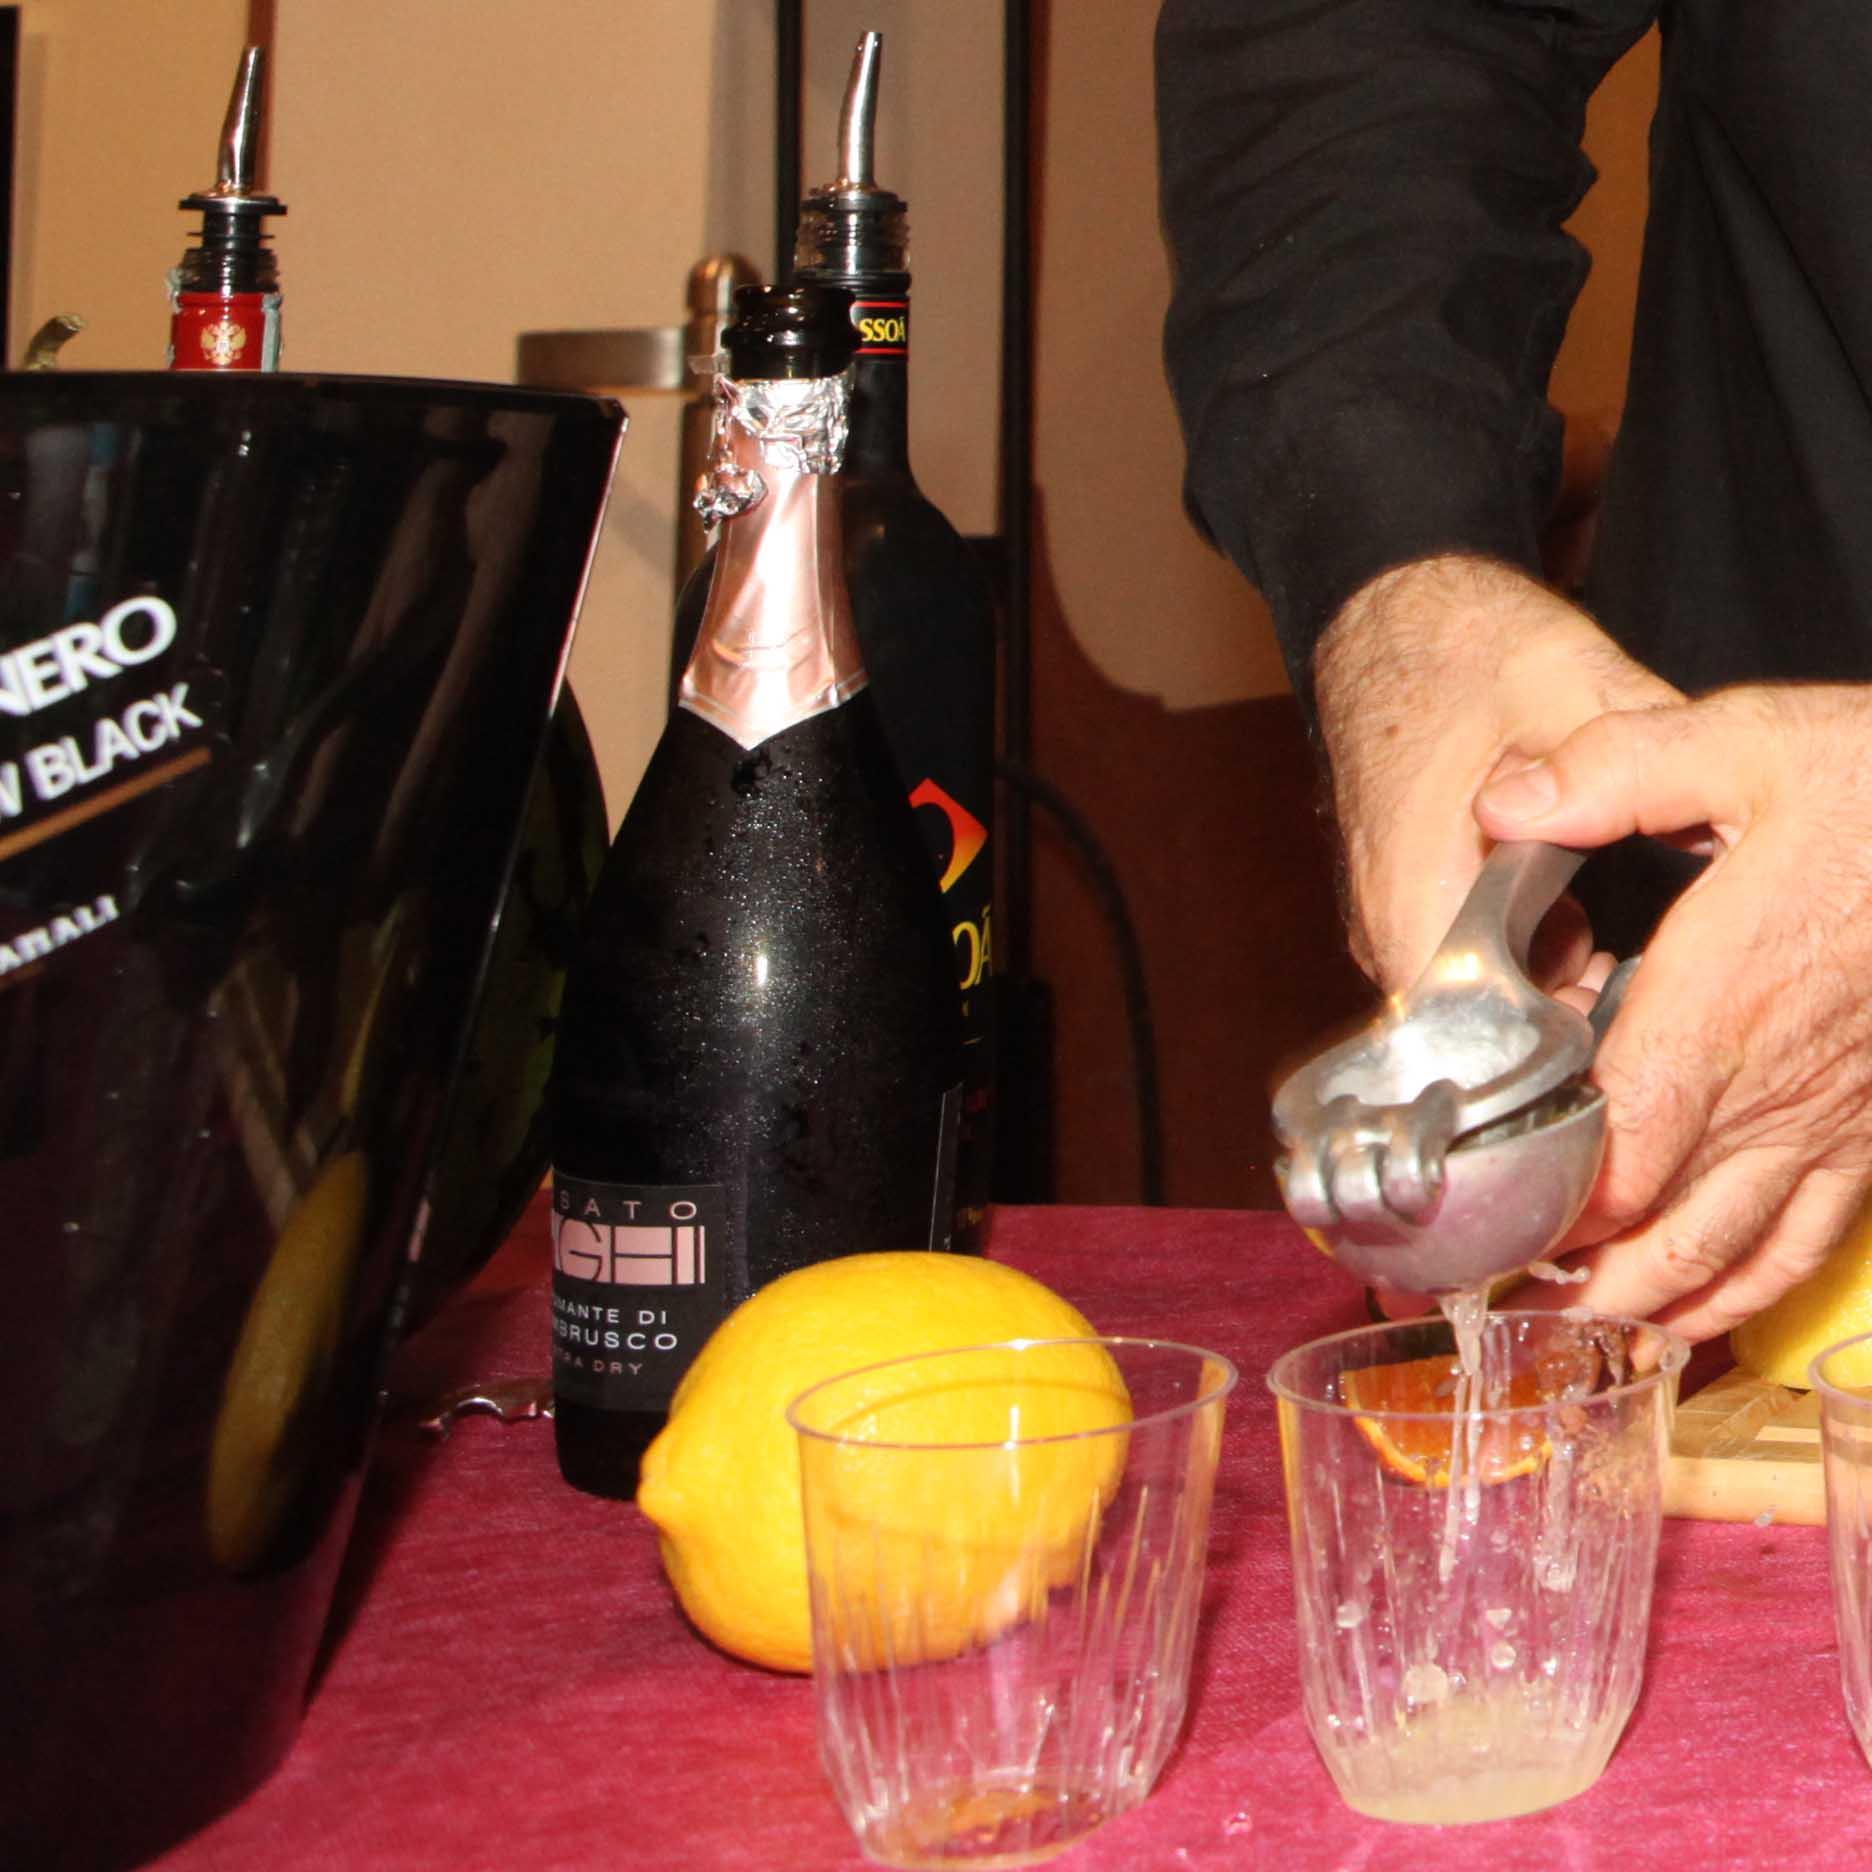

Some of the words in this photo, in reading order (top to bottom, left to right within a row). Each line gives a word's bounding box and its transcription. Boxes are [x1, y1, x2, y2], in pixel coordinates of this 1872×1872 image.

[25, 682, 203, 801] BLACK
[638, 1310, 667, 1325] DI
[593, 1359, 643, 1378] DRY
